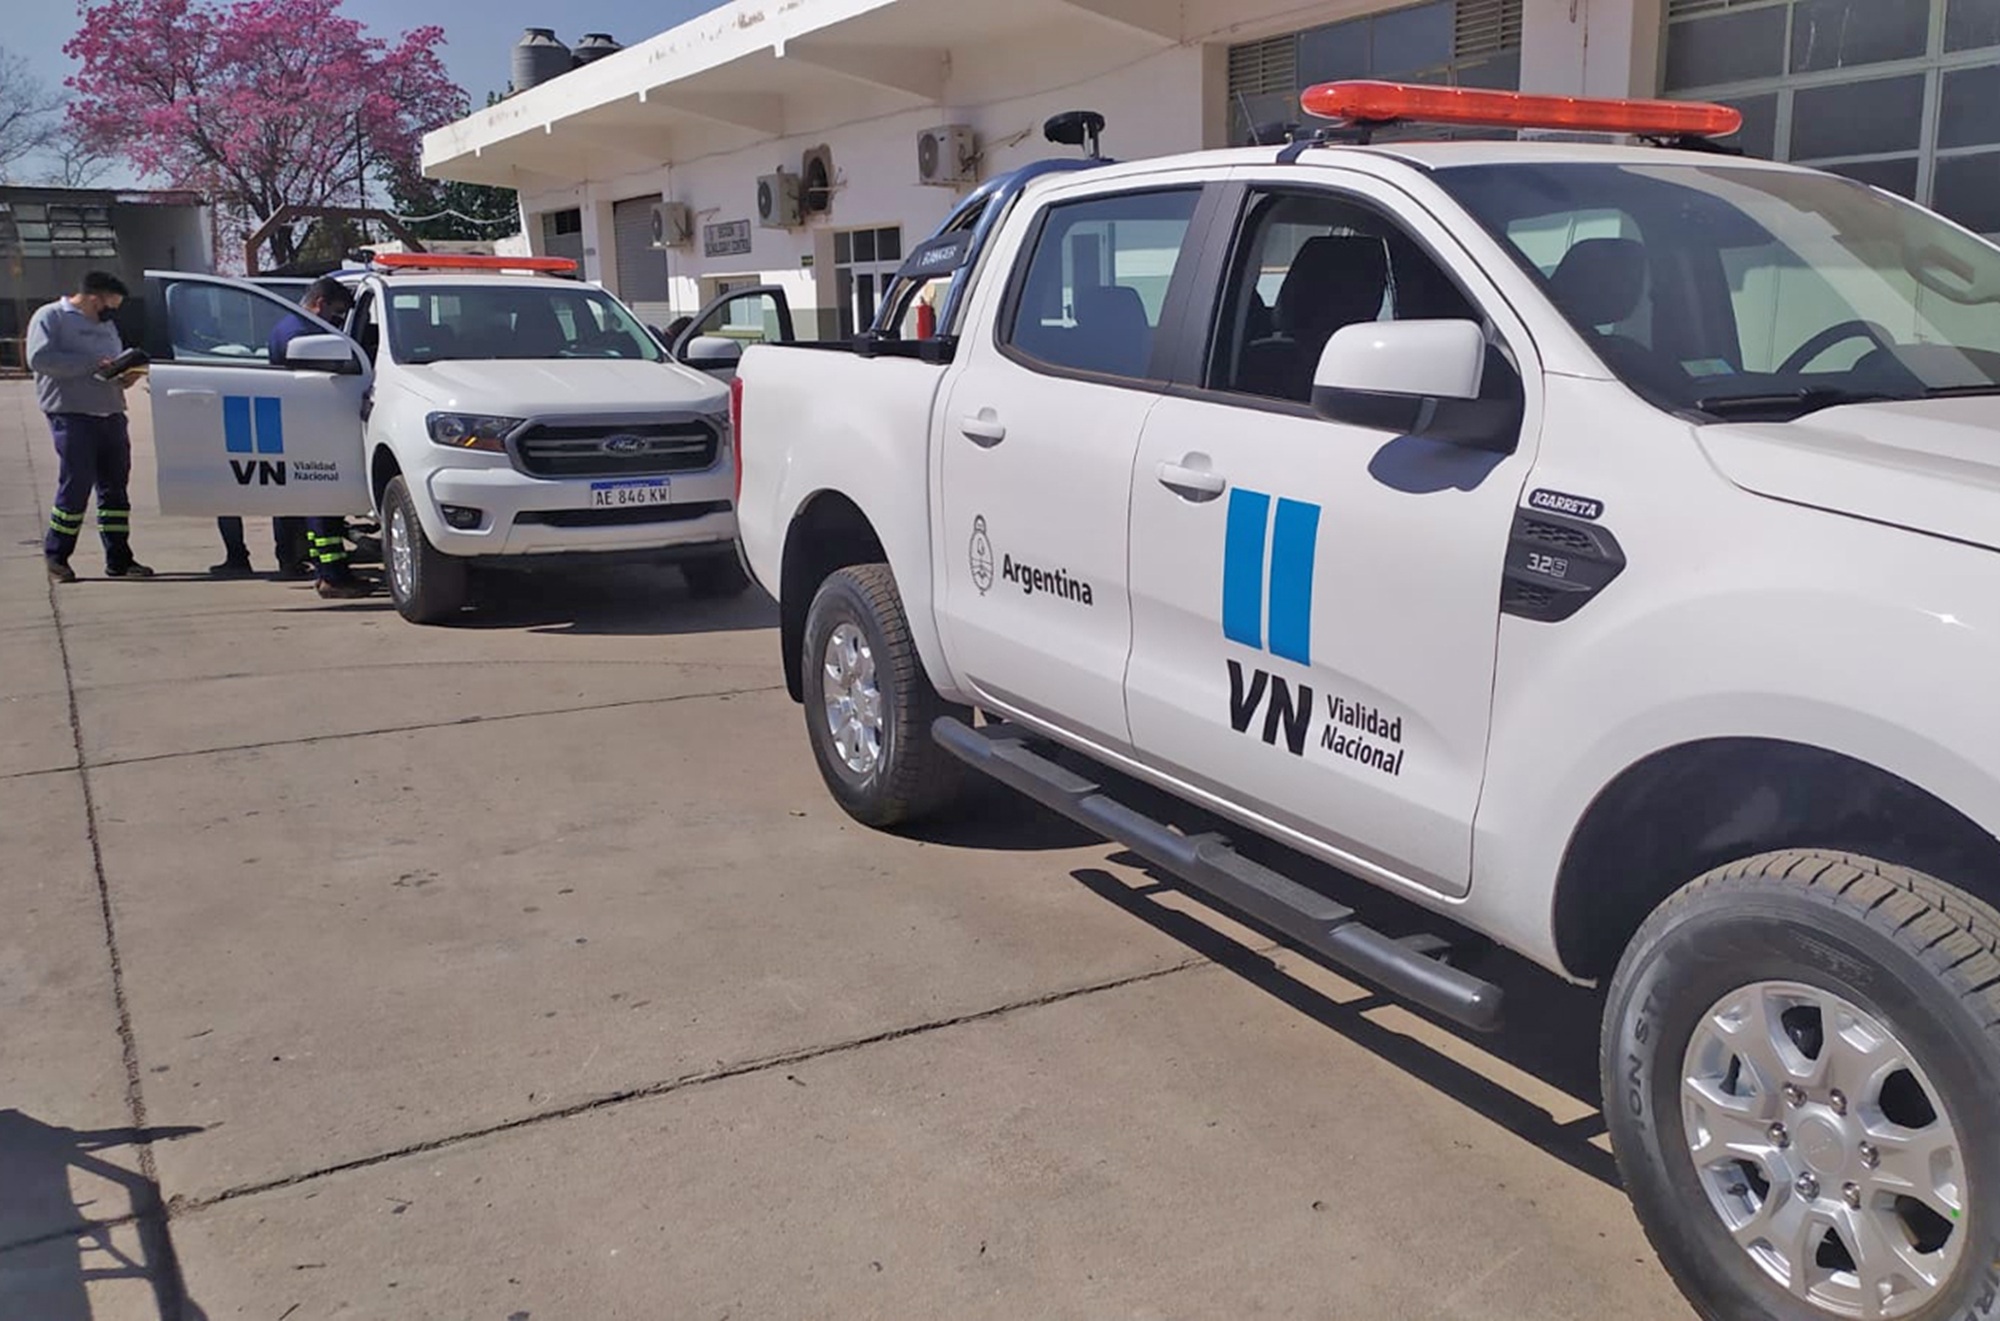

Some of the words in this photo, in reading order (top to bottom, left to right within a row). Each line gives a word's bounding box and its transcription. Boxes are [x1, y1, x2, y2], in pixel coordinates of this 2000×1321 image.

[229, 459, 287, 486] VN
[293, 460, 337, 471] Vialidad
[294, 471, 339, 482] Nacional
[596, 490, 613, 506] AE
[618, 488, 646, 505] 846
[649, 487, 668, 502] KW
[1532, 491, 1598, 517] IGARRETA
[1002, 553, 1093, 606] Argentina
[1226, 658, 1314, 757] VN
[1326, 693, 1402, 744] Vialidad
[1320, 723, 1405, 777] Nacional
